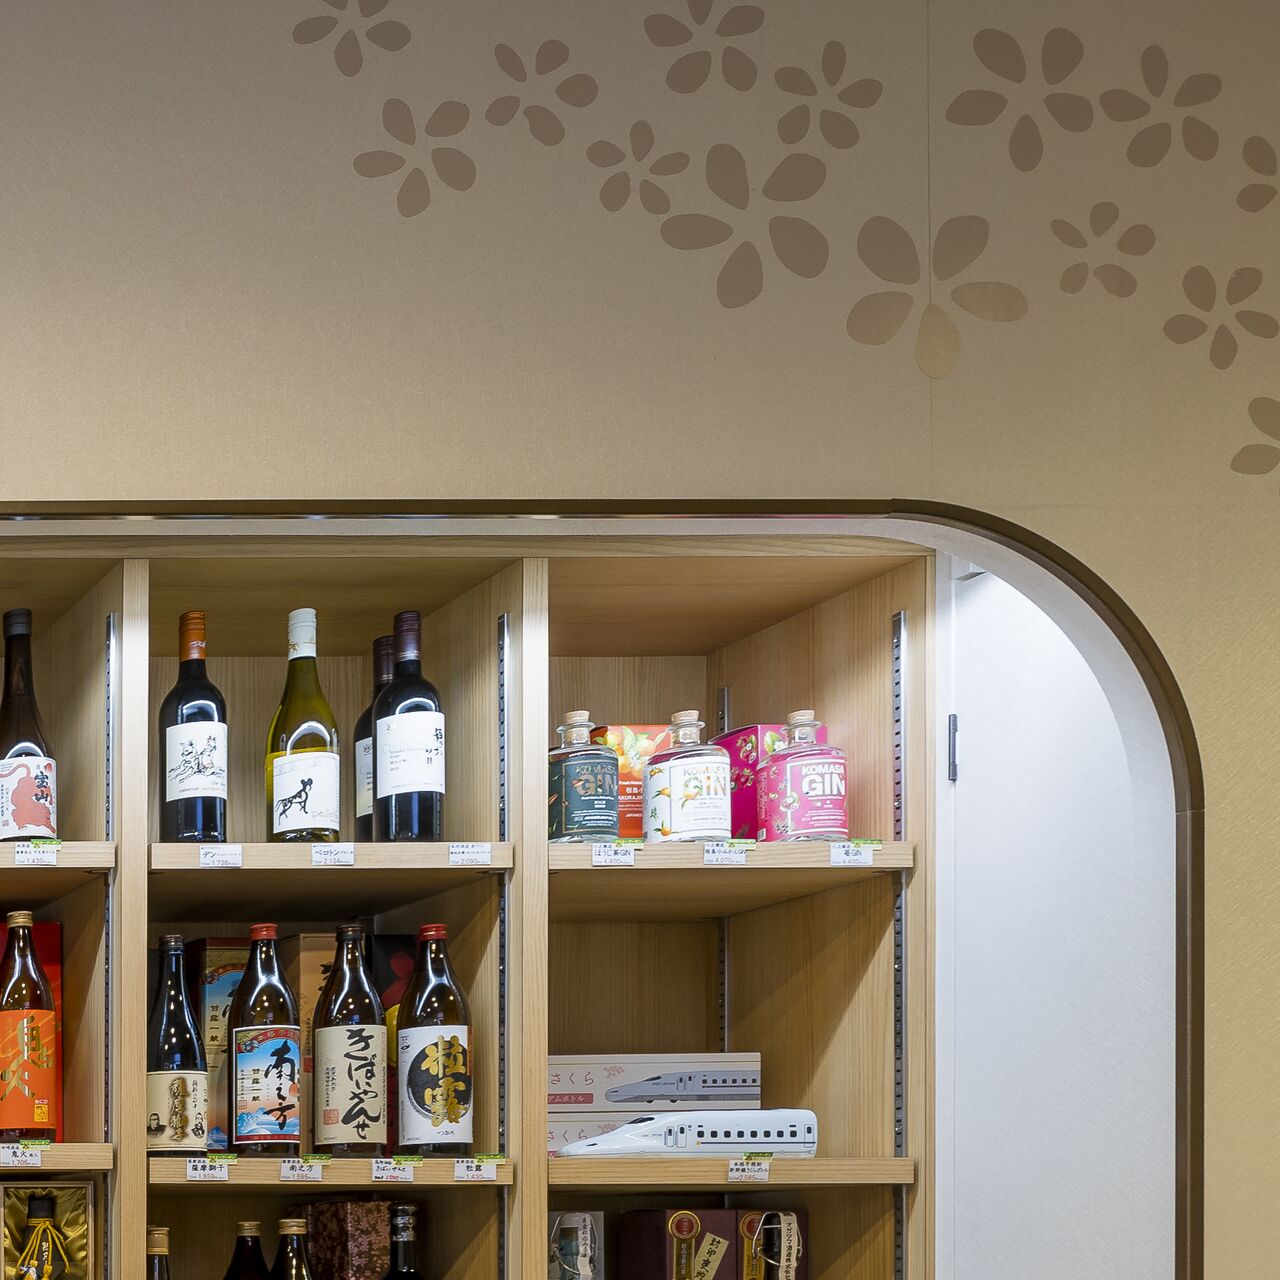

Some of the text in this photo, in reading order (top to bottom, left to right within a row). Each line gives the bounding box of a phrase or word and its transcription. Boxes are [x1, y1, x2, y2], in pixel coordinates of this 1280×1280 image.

[34, 769, 49, 803] 宝山
[802, 776, 846, 796] GIN
[264, 1040, 297, 1131] 南之方
[341, 1028, 381, 1140] きばいやんせ
[551, 1071, 594, 1086] さくら
